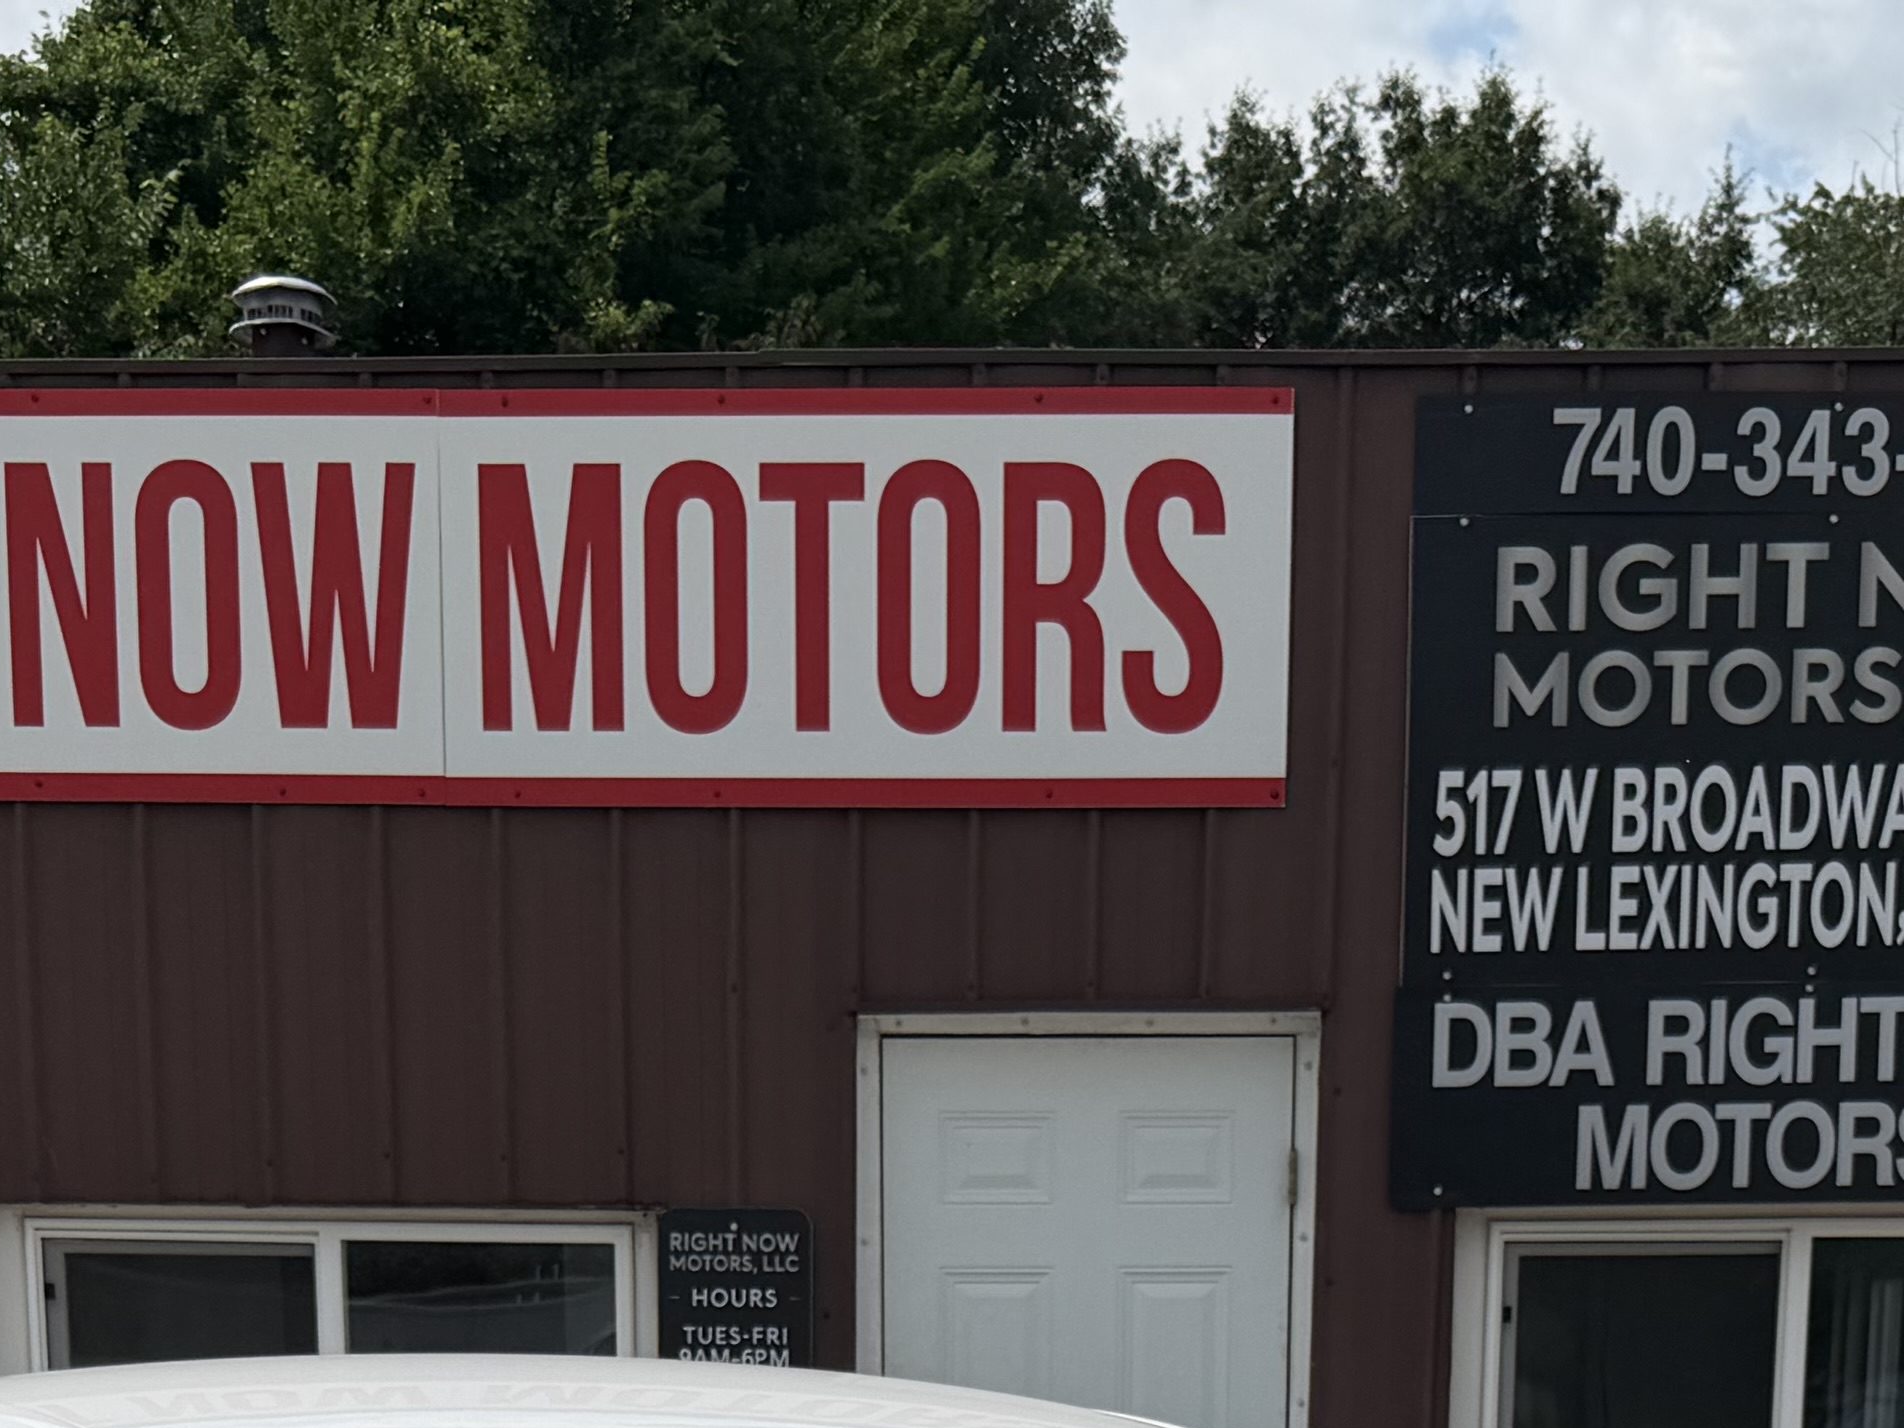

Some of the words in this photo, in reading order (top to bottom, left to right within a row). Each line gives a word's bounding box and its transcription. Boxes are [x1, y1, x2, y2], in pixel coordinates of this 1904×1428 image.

[5, 460, 415, 730] NOW
[479, 460, 1226, 734] MOTORS
[1496, 542, 1829, 631] RIGHT
[1433, 769, 1522, 856] 517
[1535, 768, 1598, 853] W
[1431, 867, 1563, 953] NEW
[1433, 1004, 1614, 1087] DBA
[669, 1232, 737, 1252] RIGHT
[742, 1232, 799, 1253] NOW
[669, 1254, 758, 1275] MOTORS,
[762, 1254, 800, 1273] LLC
[682, 1325, 788, 1345] TUES-FRI
[691, 1287, 778, 1308] HOURS
